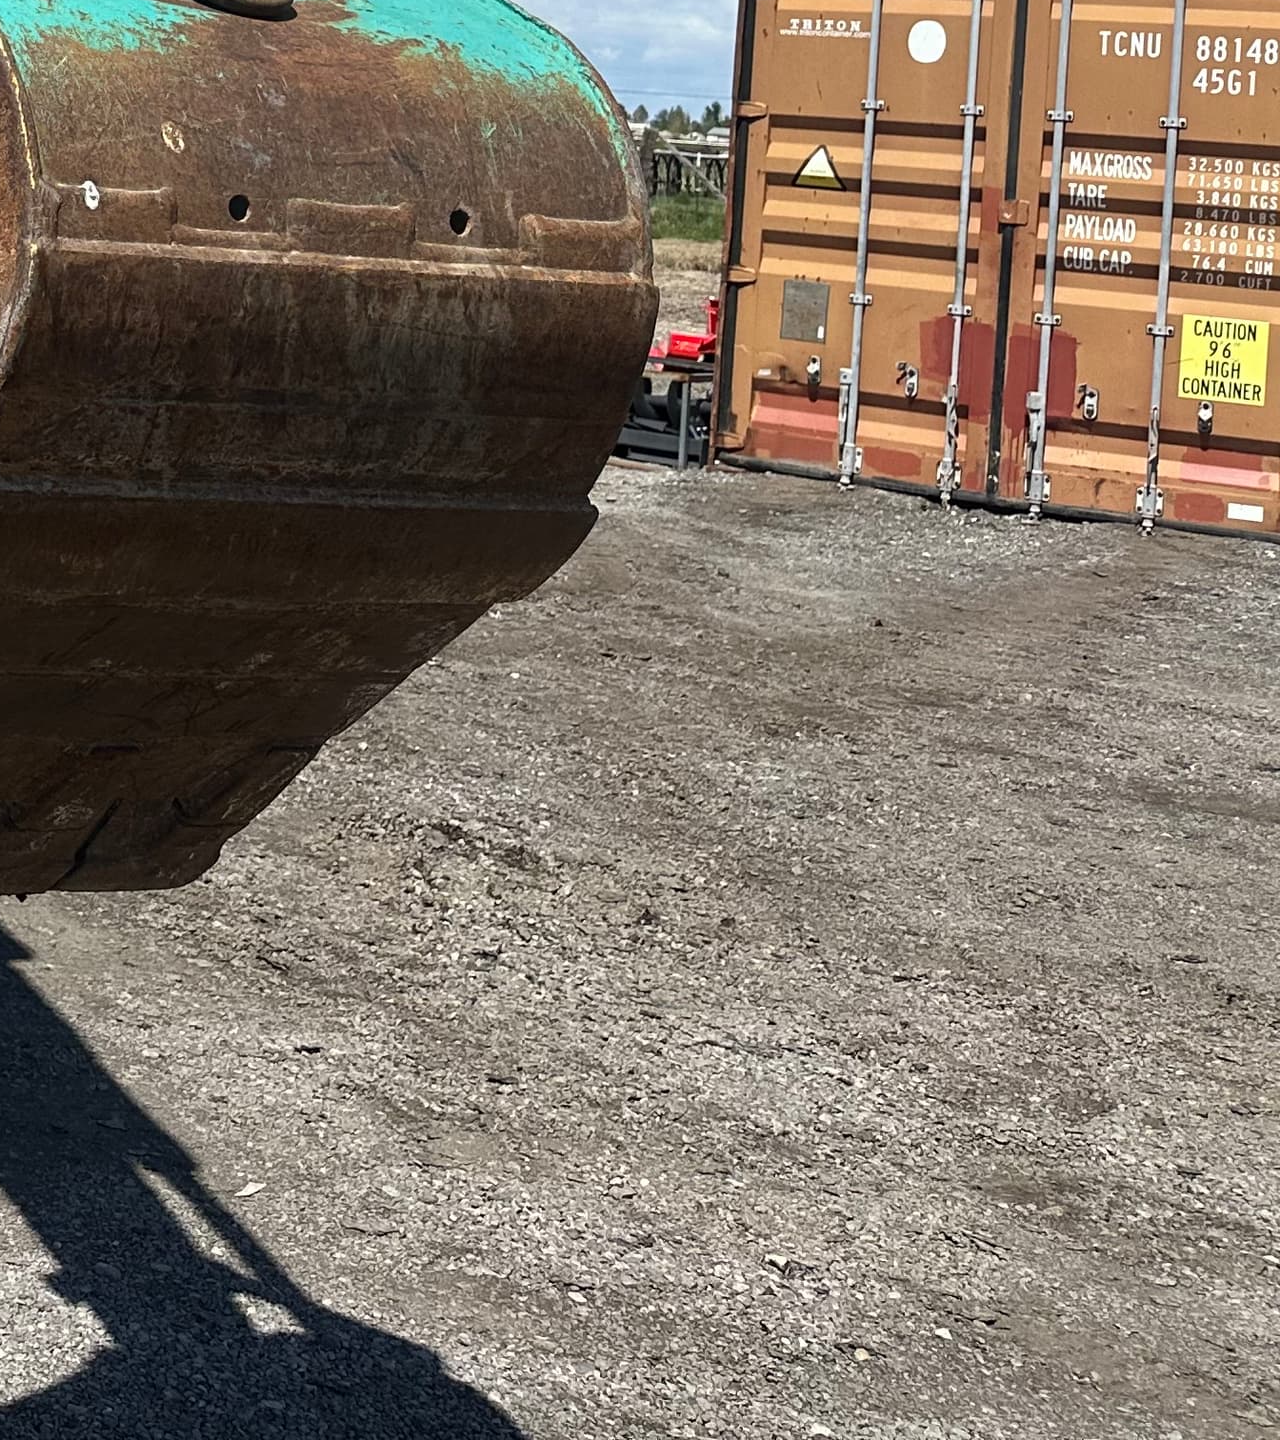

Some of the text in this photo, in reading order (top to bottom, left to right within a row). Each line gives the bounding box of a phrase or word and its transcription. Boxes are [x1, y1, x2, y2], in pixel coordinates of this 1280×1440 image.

[790, 18, 862, 32] TRITON
[1099, 30, 1279, 65] TCNU 88148
[1192, 68, 1257, 96] 45G1
[1069, 150, 1152, 181] MAXGROSS
[1252, 161, 1280, 178] KGS
[1068, 182, 1108, 209] TARE
[1249, 195, 1279, 211] KGS
[1251, 178, 1279, 194] LBS
[1064, 213, 1136, 244] PAYLOAD
[1247, 227, 1276, 243] KGS
[1248, 212, 1277, 225] LBS
[1246, 243, 1275, 259] LBS
[1191, 254, 1226, 271] 76.4
[1245, 259, 1274, 276] CUM
[1238, 276, 1272, 290] CUFT
[1193, 319, 1257, 342] CAUTION
[1204, 360, 1241, 379] HIGH
[1182, 377, 1262, 402] CONTAINER
